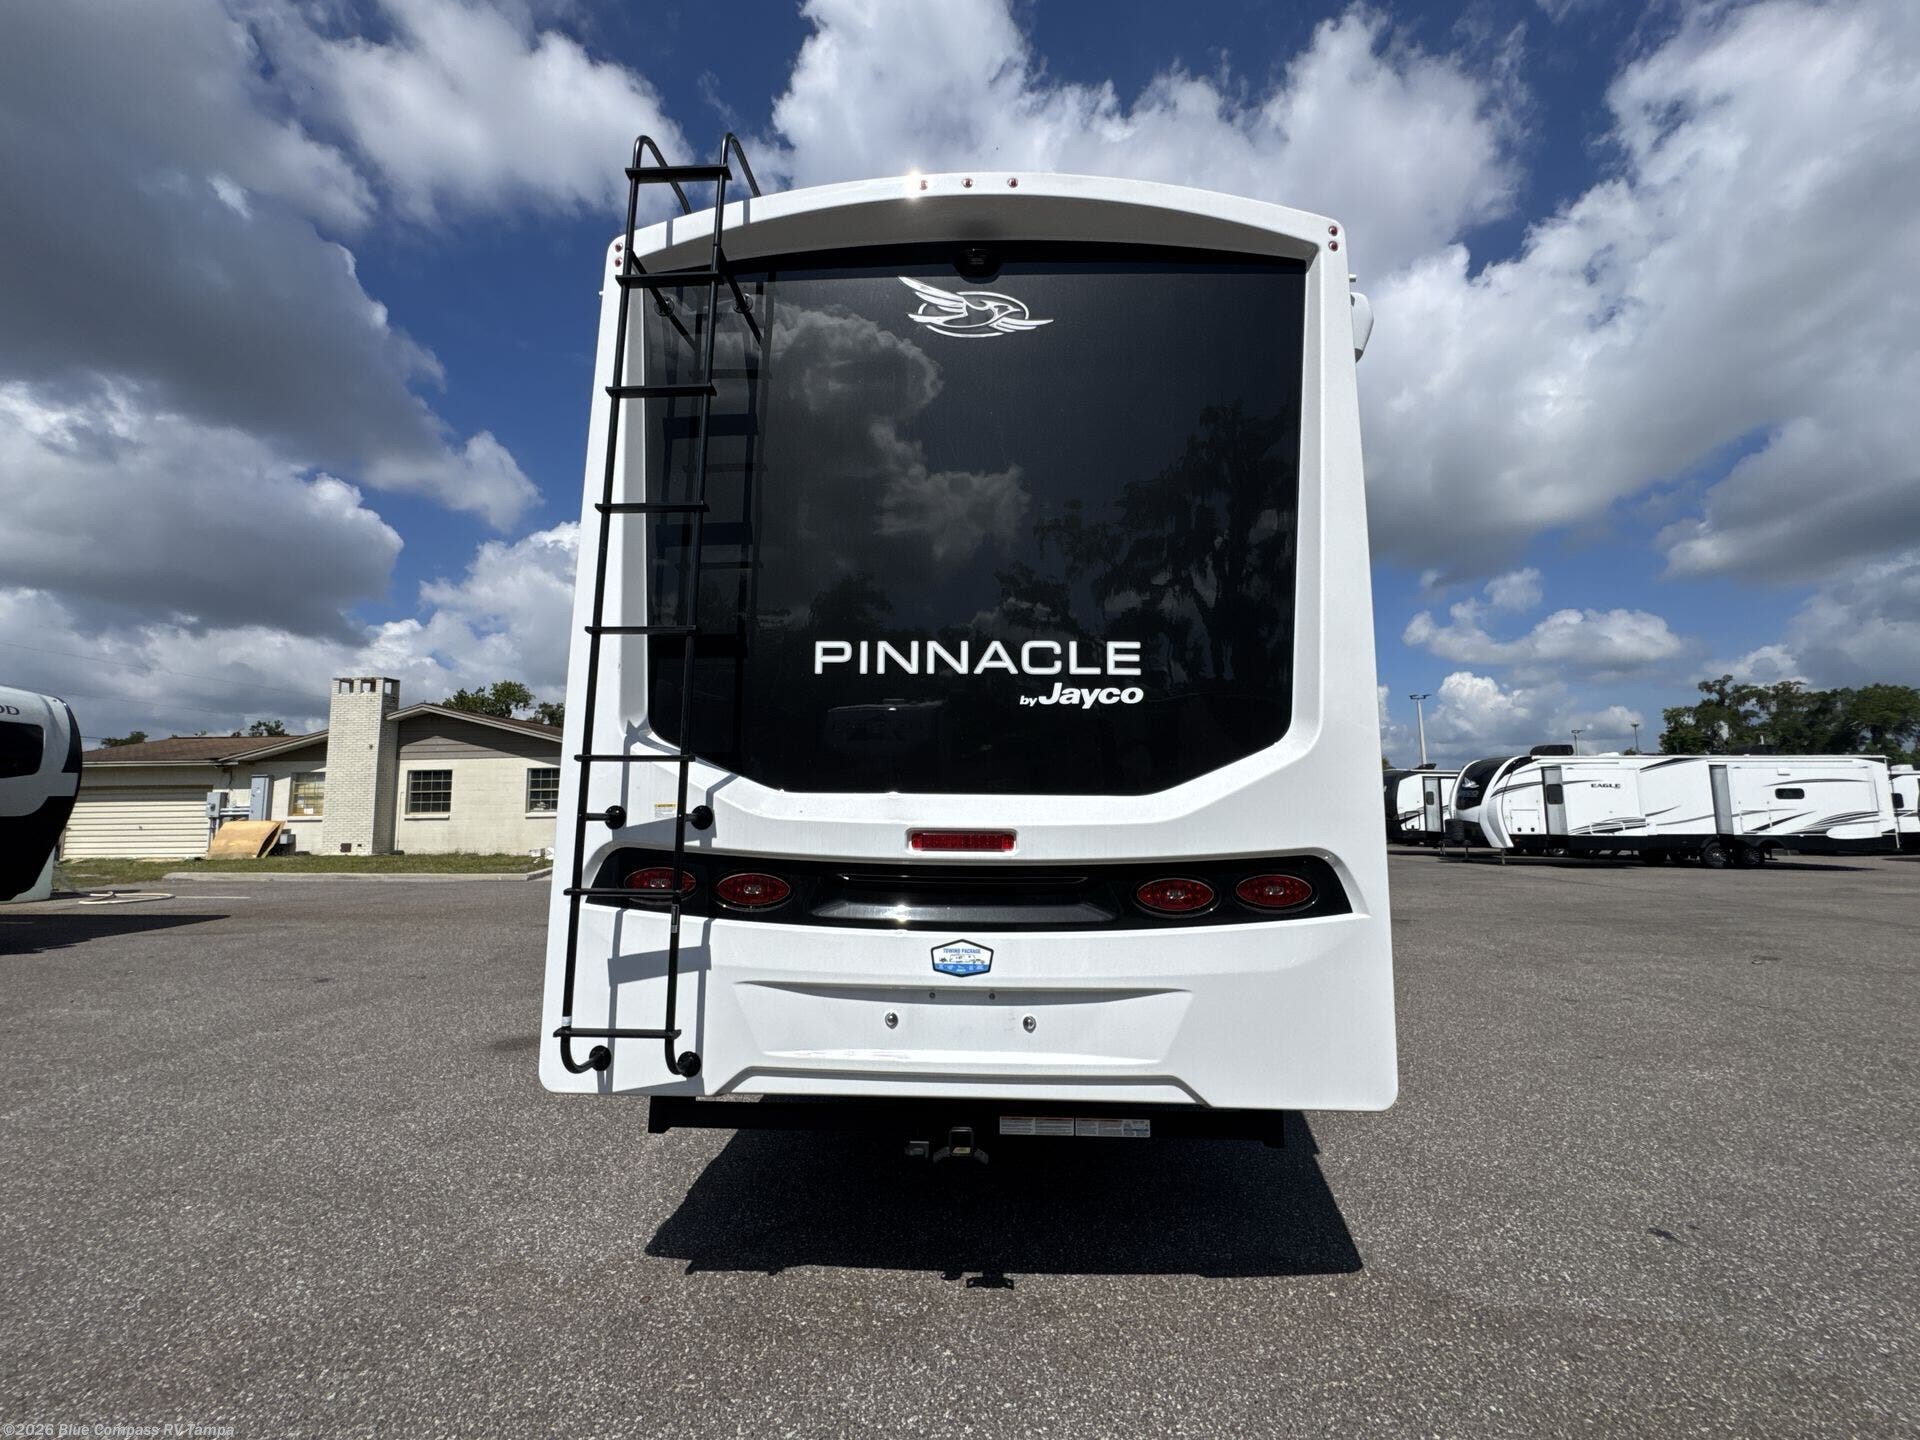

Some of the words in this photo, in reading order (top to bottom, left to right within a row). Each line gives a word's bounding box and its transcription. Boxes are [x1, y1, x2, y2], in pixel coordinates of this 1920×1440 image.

[814, 640, 1142, 676] PINNACLE
[1019, 695, 1037, 706] by
[1038, 682, 1144, 709] Jayco
